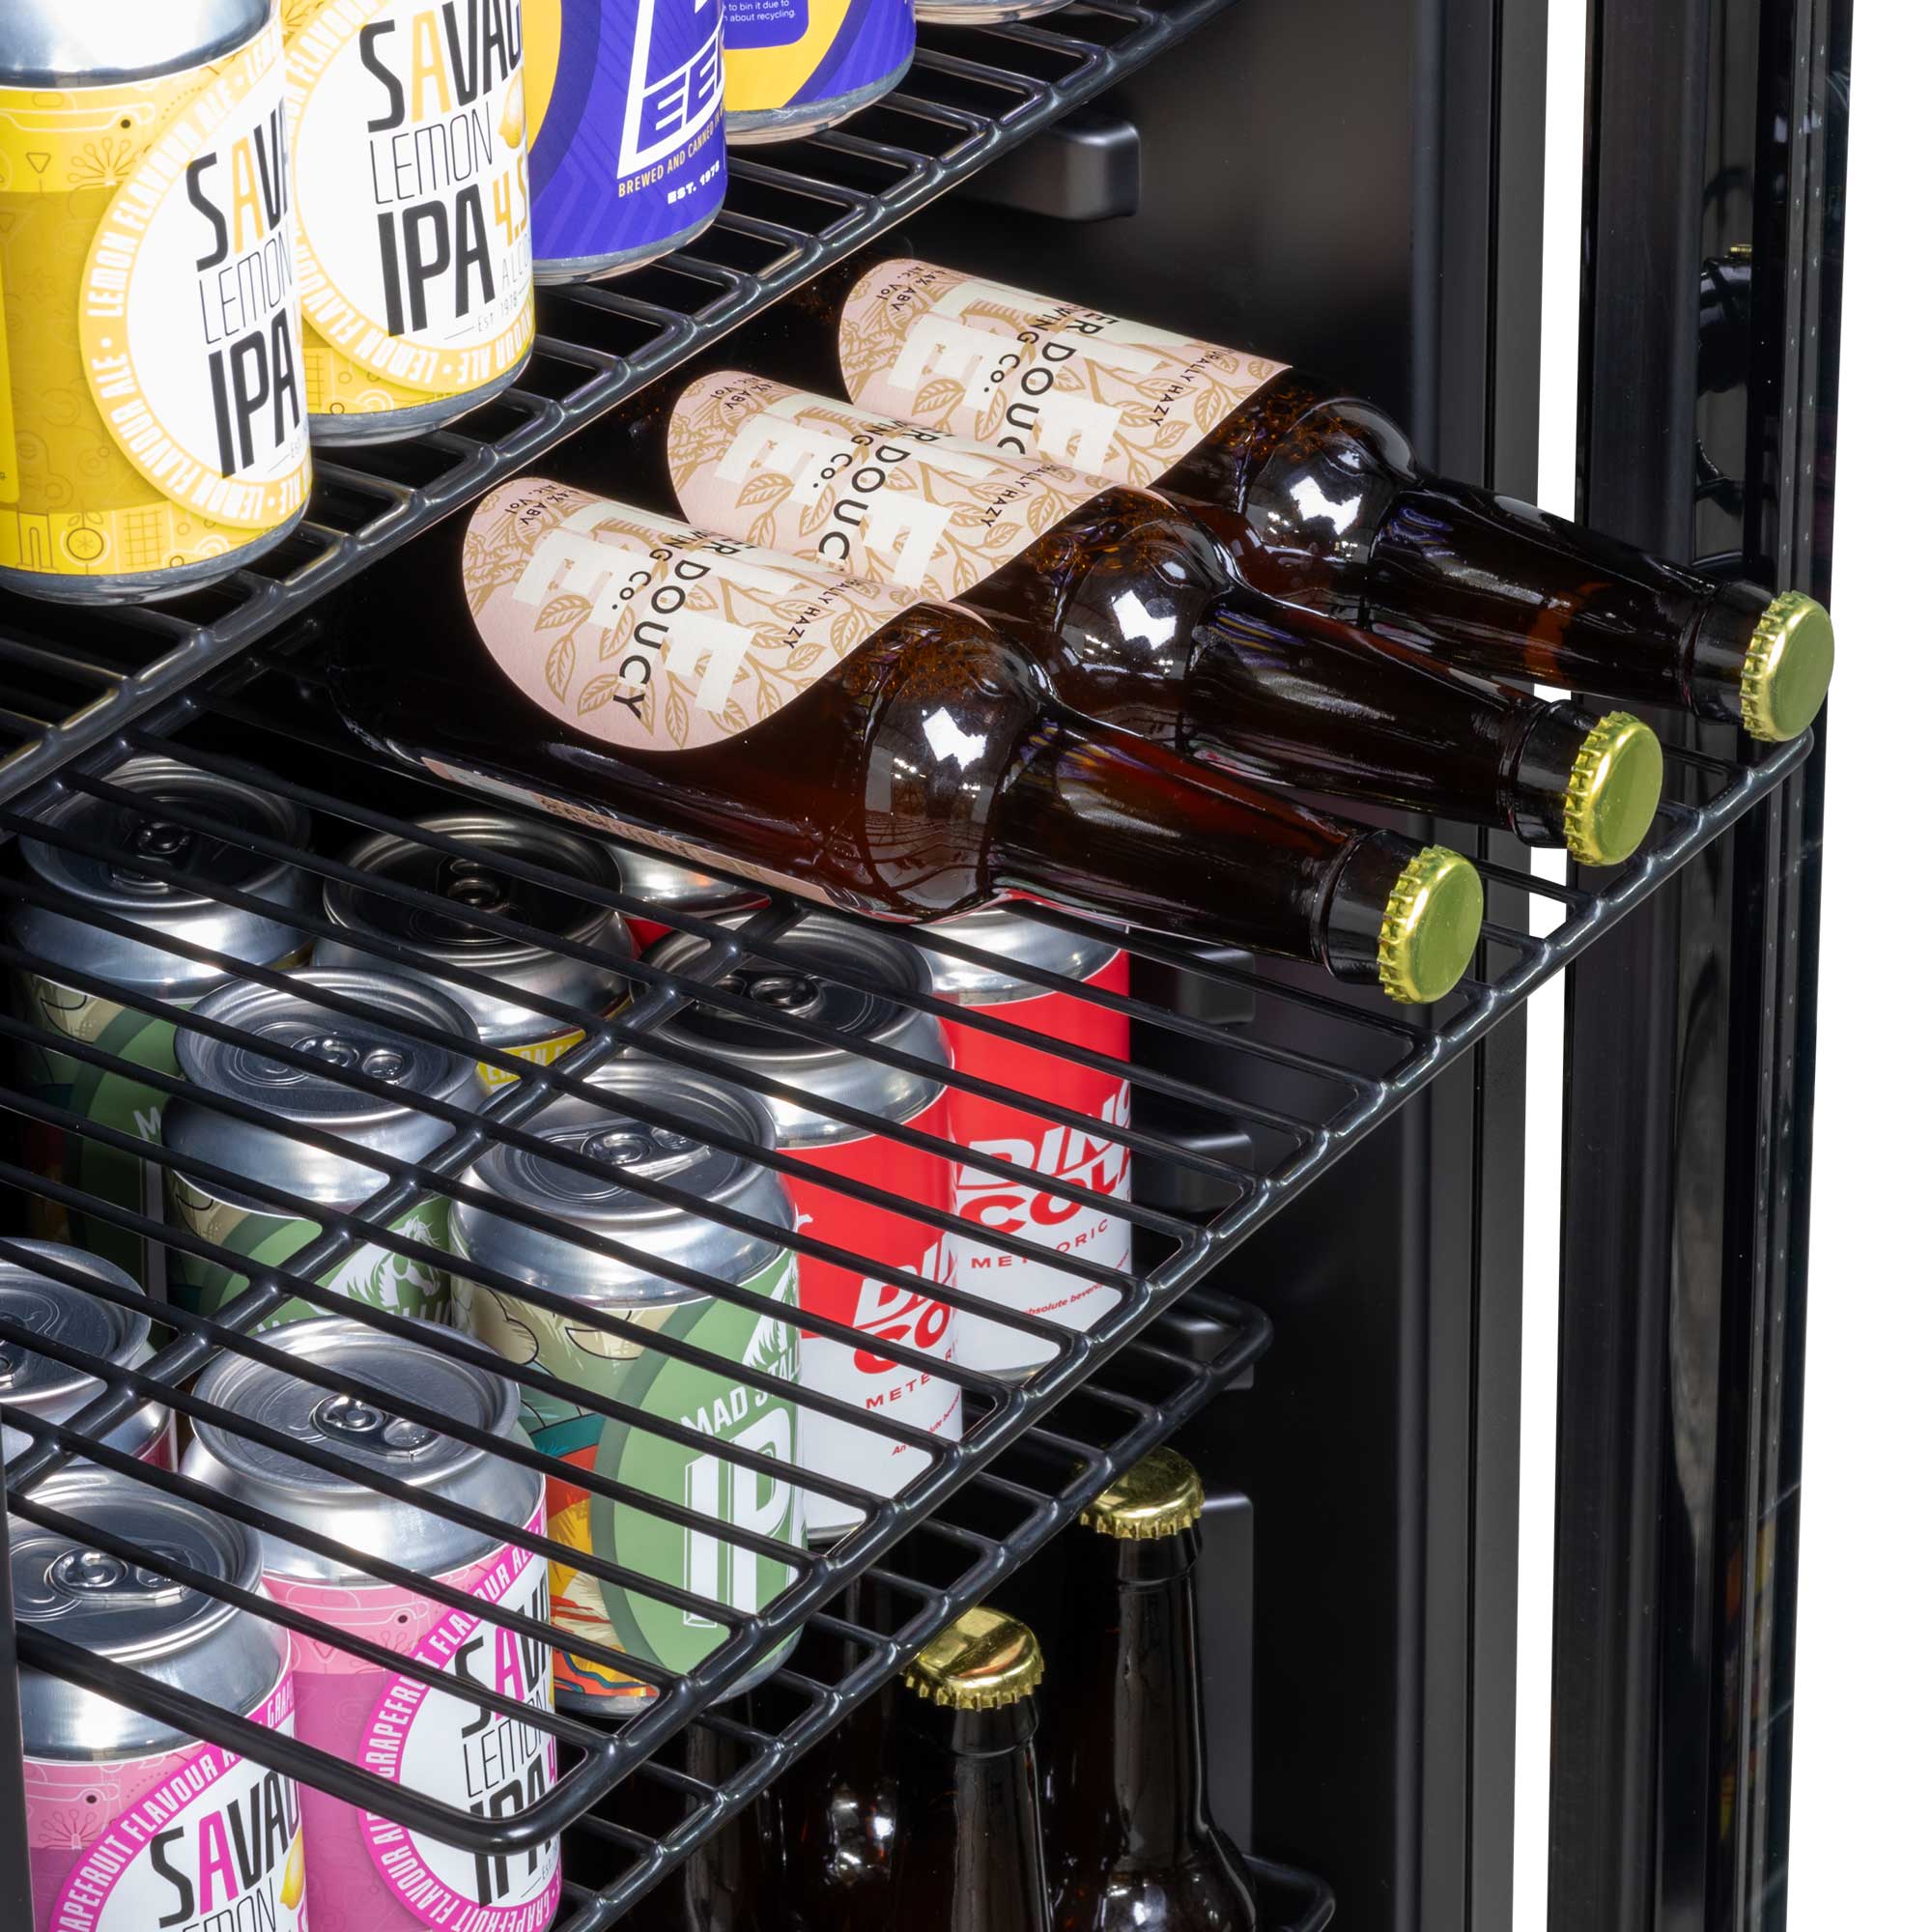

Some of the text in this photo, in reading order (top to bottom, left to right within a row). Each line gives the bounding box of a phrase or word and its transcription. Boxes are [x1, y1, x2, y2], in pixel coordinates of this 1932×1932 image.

[728, 3, 737, 12] to
[740, 3, 753, 12] bin
[763, 1, 779, 10] due
[730, 14, 755, 22] about
[112, 121, 199, 231] FLAVOUR
[370, 100, 494, 205] LEMON
[618, 163, 665, 198] BREWED
[667, 150, 686, 175] AND
[688, 121, 715, 158] CANNED
[87, 231, 139, 318] LEMON
[378, 184, 497, 338] IPA
[199, 230, 292, 345] LEMON
[876, 283, 902, 300] Vol
[892, 286, 918, 312] ABV
[354, 327, 440, 384] LEMON
[457, 346, 492, 384] ALE
[983, 354, 1021, 393] Co.
[208, 307, 300, 479] IPA
[996, 341, 1077, 455] DOUC
[1150, 384, 1184, 427] HAZY
[92, 353, 265, 521] LEMON FLAVOUR ALE
[812, 453, 853, 489] Co.
[504, 497, 533, 515] Vol
[520, 501, 548, 526] ABV
[818, 444, 912, 560] DOUC
[980, 489, 1019, 528] HAZY
[611, 570, 652, 611] Co.
[611, 558, 712, 720] DOUCY
[782, 606, 822, 649] HAZY
[971, 1219, 1109, 1269] MEORIC
[679, 1385, 749, 1436] MAD
[120, 1753, 218, 1843] FLAVOUR
[380, 1846, 460, 1924] FLAVOUR
